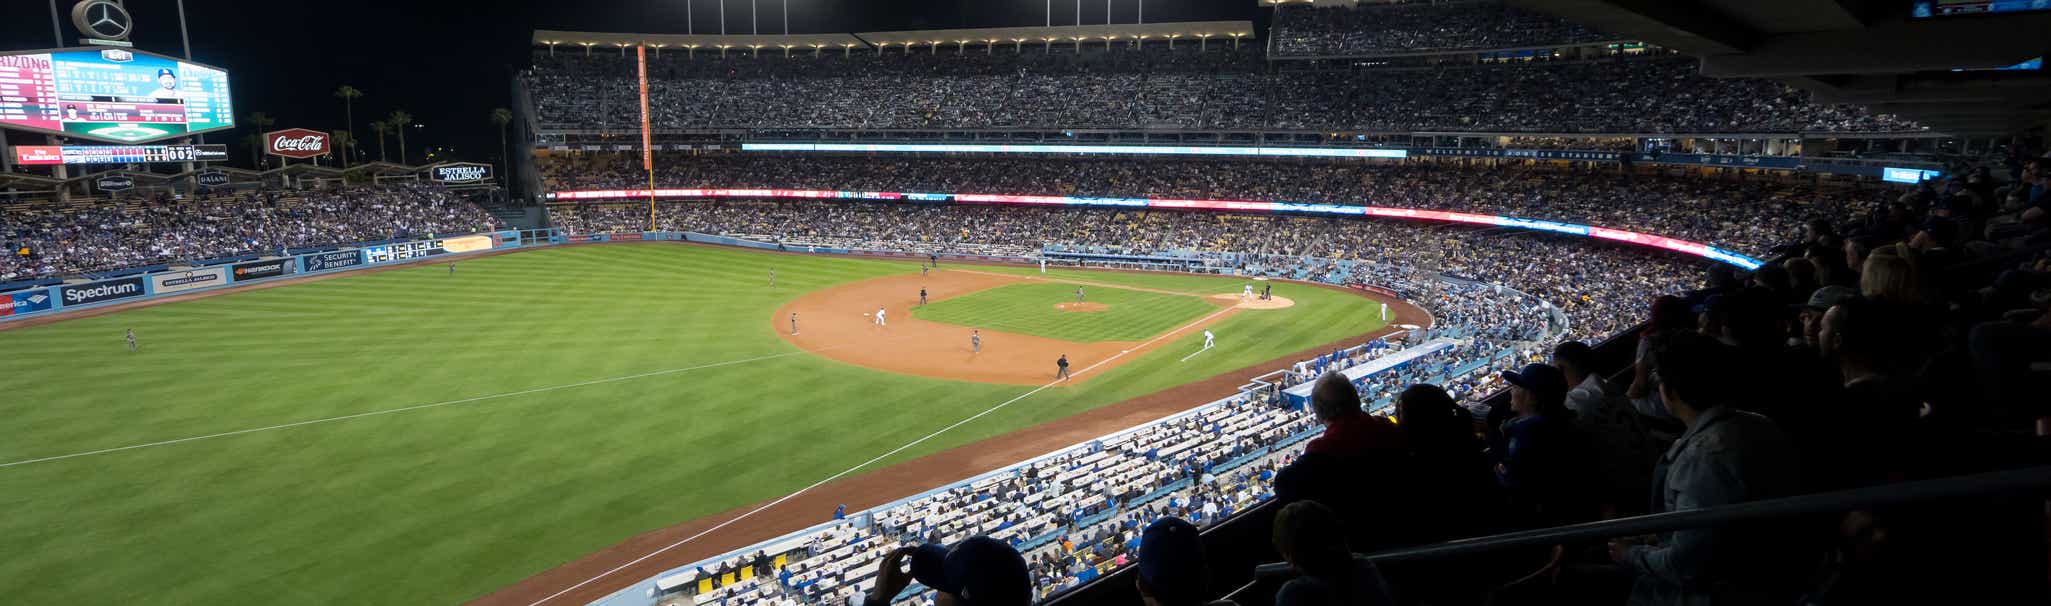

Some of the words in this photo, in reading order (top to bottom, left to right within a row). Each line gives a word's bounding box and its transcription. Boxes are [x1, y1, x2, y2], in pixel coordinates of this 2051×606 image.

[274, 135, 323, 151] Coca-Cola
[439, 167, 485, 175] ESTRELLA
[444, 173, 481, 181] JALISCO
[323, 251, 357, 261] SECURITY
[324, 260, 353, 268] BENEFIT
[66, 283, 136, 302] Spectrum
